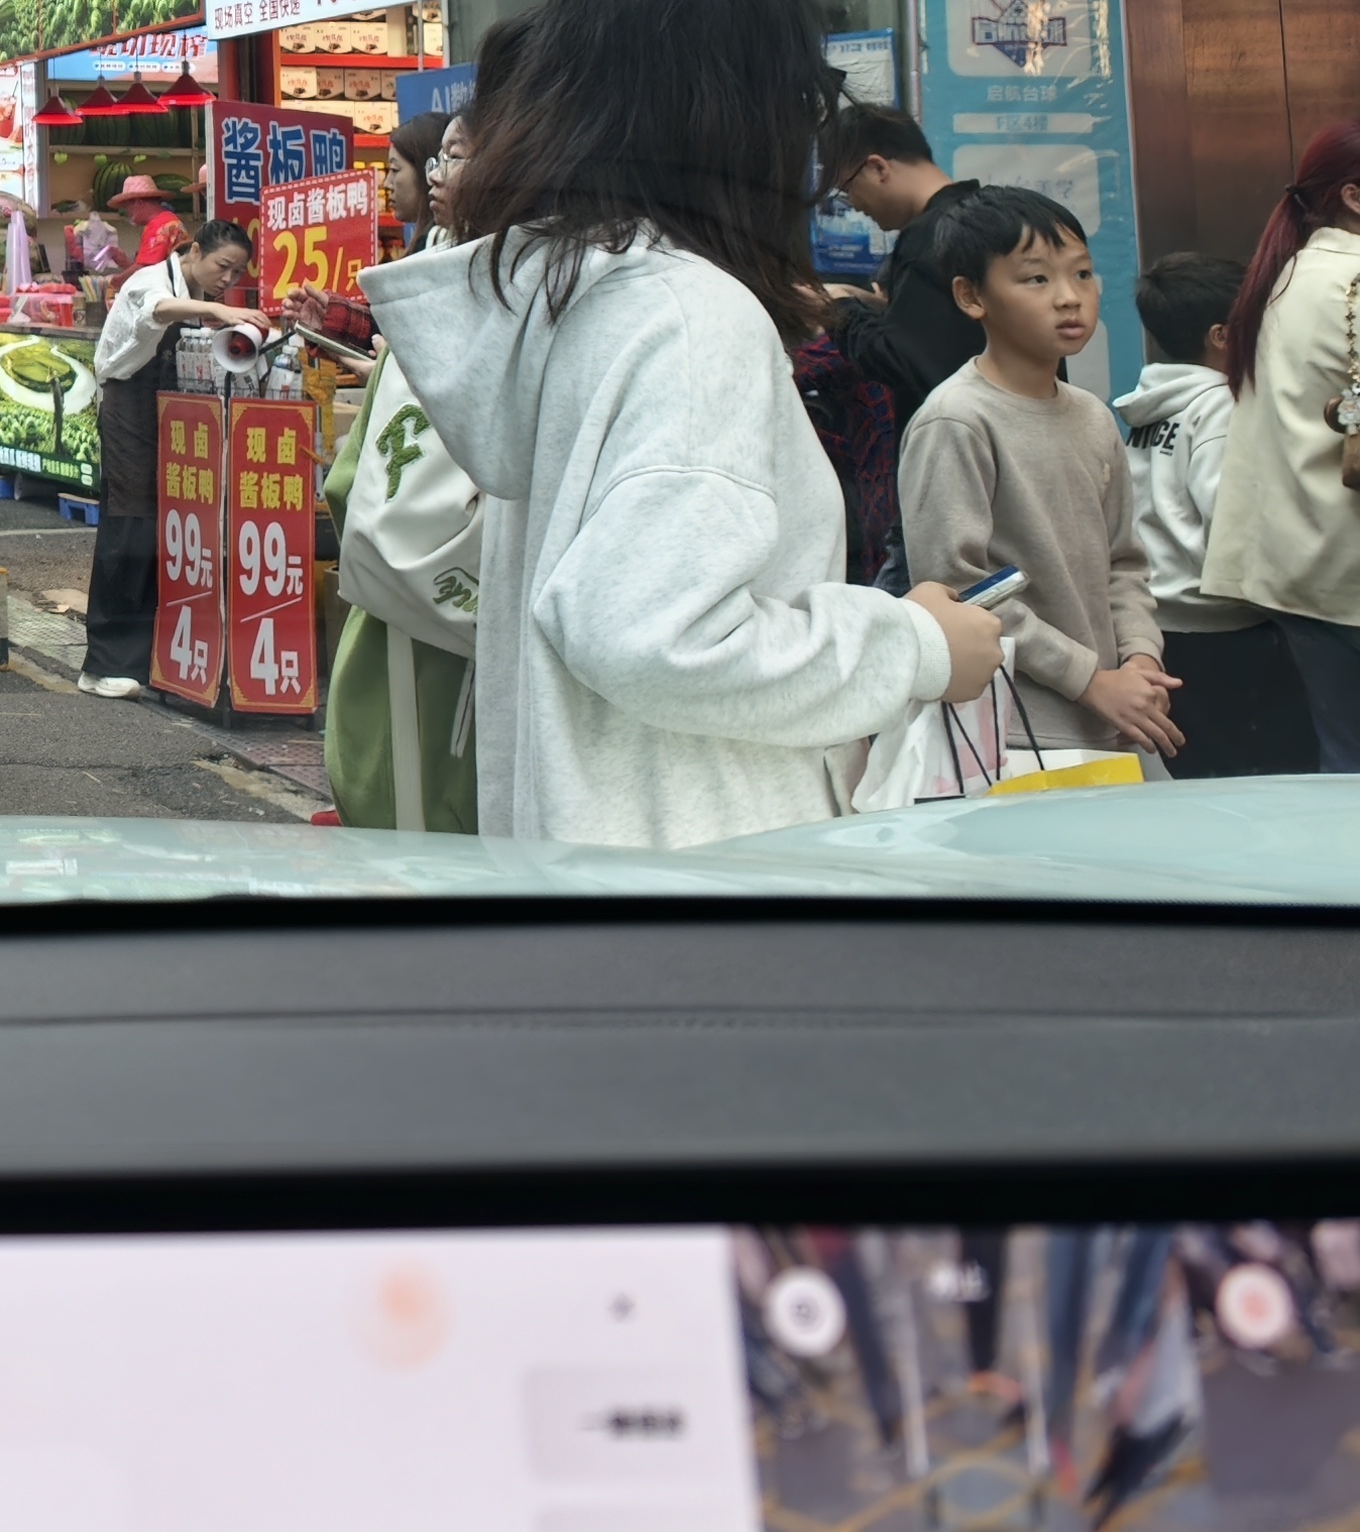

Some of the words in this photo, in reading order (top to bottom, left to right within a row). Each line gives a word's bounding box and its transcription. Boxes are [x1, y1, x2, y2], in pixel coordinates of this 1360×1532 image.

[214, 2, 254, 30] 现场真空
[221, 116, 348, 206] 酱板鸭
[266, 178, 369, 231] 现卤酱板鸭
[170, 419, 210, 460] 现卤
[246, 426, 297, 465] 现卤
[165, 461, 214, 505] 酱板鸭
[239, 471, 304, 512] 酱板鸭
[165, 508, 213, 589] 99元
[238, 520, 304, 597] 99元
[169, 605, 209, 685] 4只
[250, 617, 303, 696] 4只
